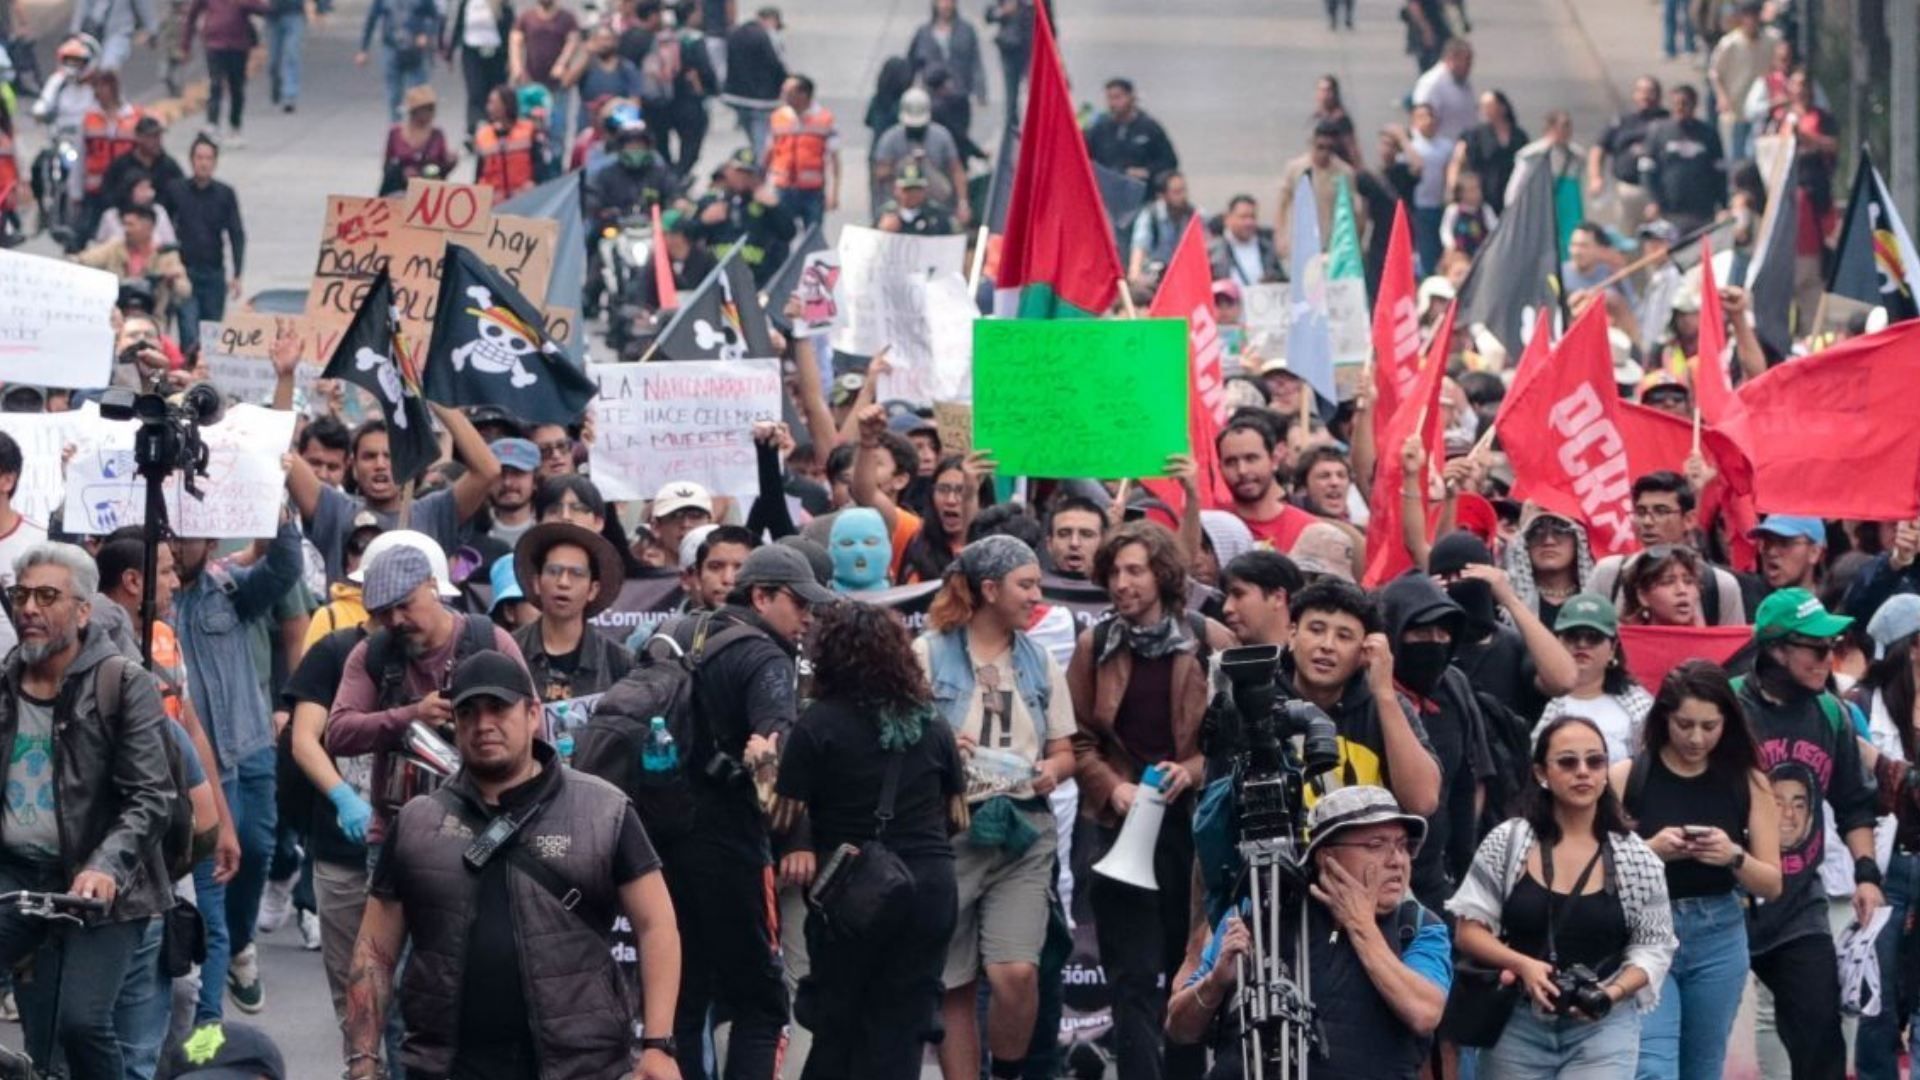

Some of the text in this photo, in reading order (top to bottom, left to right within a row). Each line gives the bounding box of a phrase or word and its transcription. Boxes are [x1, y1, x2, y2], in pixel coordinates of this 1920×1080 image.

[406, 186, 477, 230] NO
[488, 218, 539, 268] hay
[317, 244, 391, 276] nada
[221, 327, 265, 355] que
[596, 373, 633, 402] LA
[601, 407, 632, 425] TE
[643, 407, 689, 425] HACE
[650, 429, 741, 448] MUERTE
